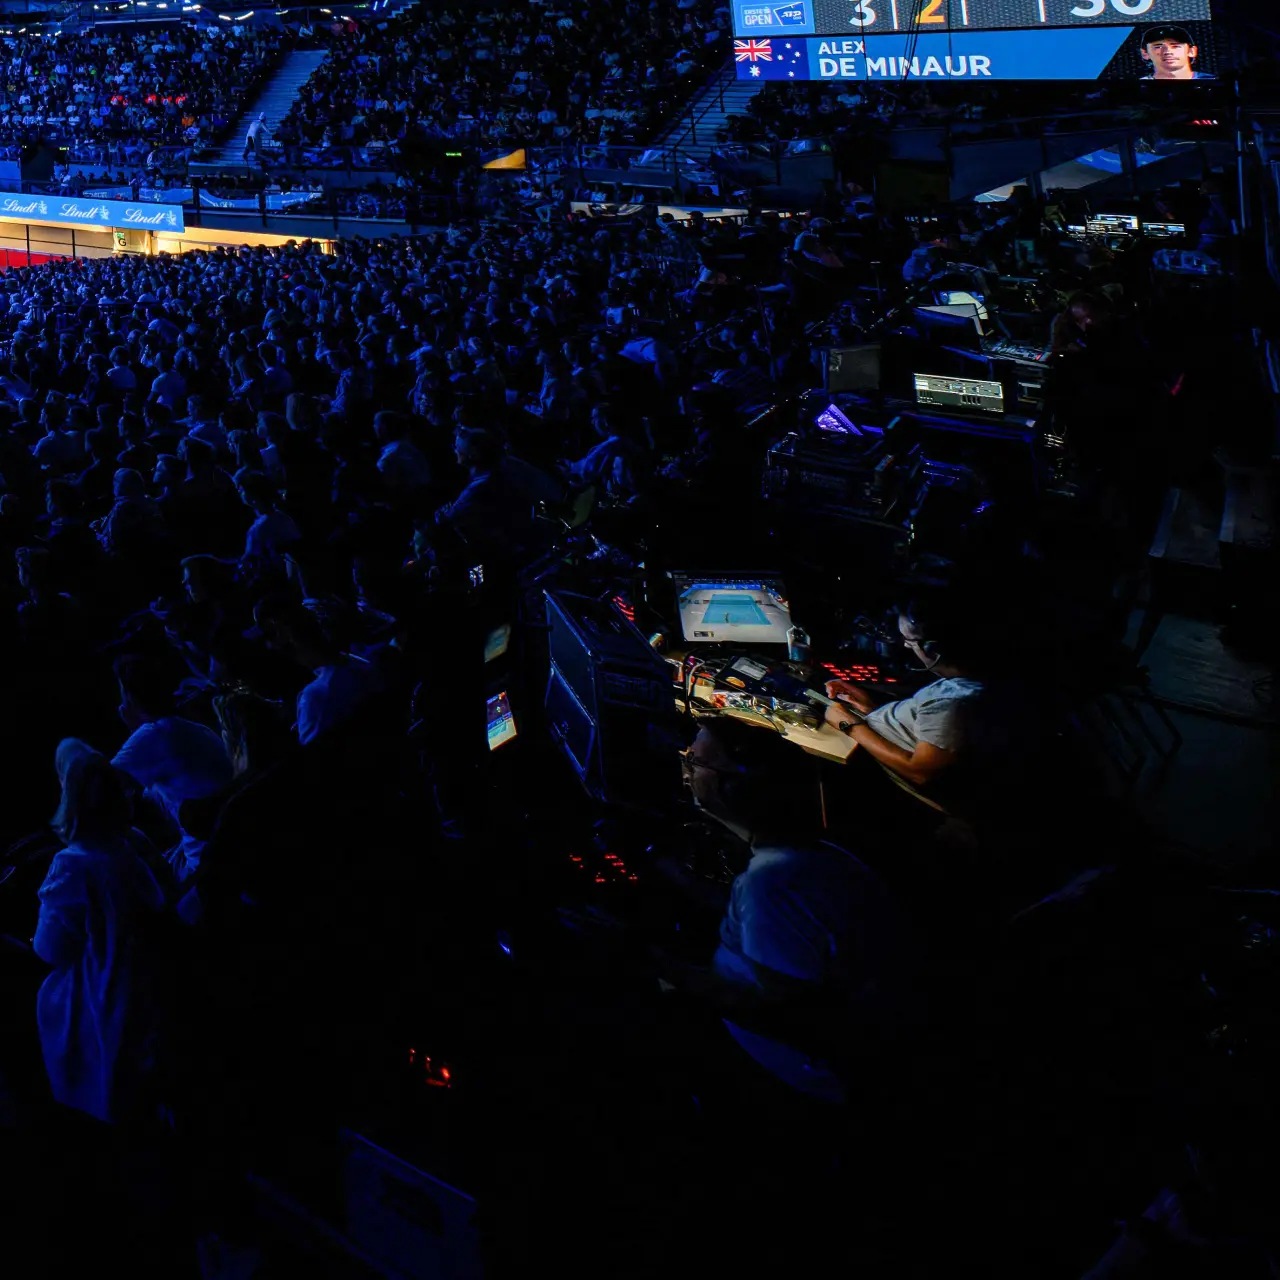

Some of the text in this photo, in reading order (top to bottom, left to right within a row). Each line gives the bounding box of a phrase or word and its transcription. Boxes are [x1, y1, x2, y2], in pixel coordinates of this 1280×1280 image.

[745, 13, 773, 25] OPEN
[818, 40, 866, 55] ALEX
[819, 55, 992, 77] DE MINAUR
[1, 198, 166, 224] Lindt Lindt Lindt
[118, 237, 127, 247] G
